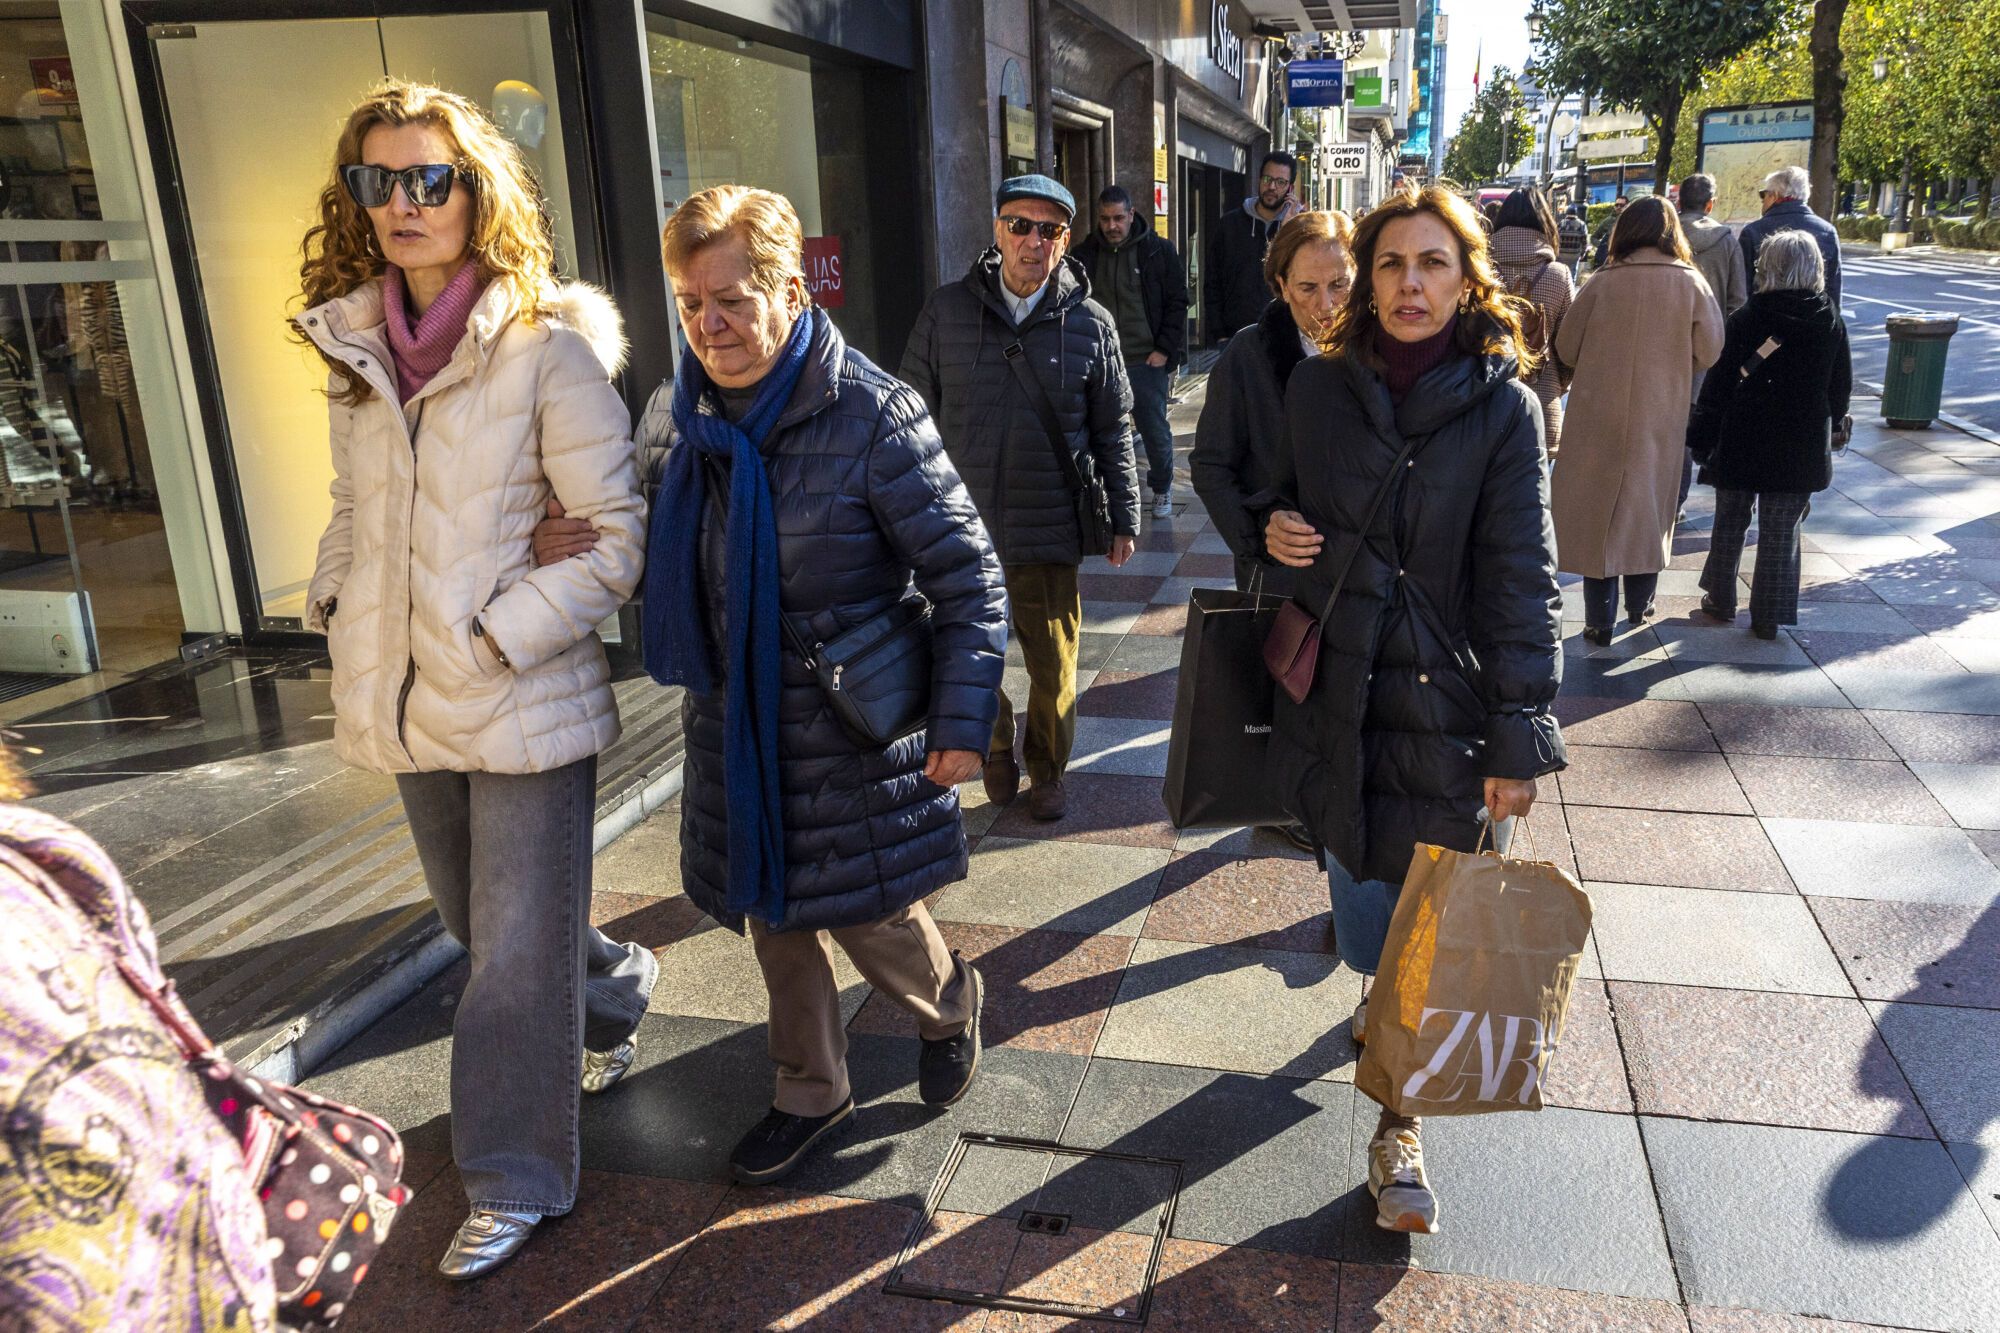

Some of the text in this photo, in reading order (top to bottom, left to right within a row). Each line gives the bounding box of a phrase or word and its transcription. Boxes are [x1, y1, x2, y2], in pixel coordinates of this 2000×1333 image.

[1218, 4, 1240, 80] Sfera
[1737, 126, 1780, 137] OVIEDO
[1334, 157, 1360, 168] ORO
[1244, 724, 1272, 734] Massim
